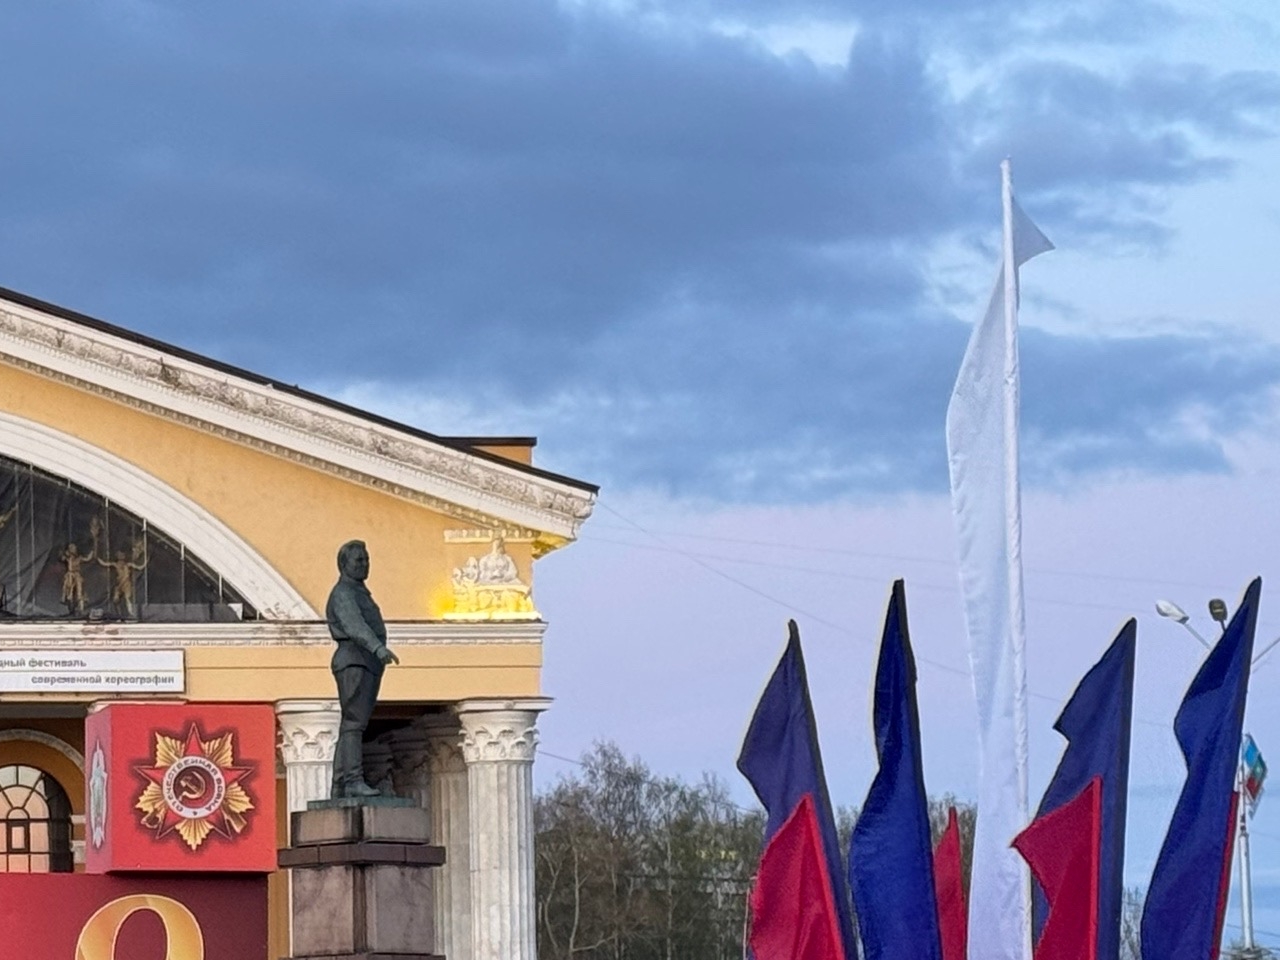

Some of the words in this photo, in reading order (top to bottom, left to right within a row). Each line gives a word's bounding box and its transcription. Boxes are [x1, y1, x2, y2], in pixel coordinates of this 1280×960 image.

[28, 657, 87, 668] фестиваль
[31, 674, 102, 686] современной
[105, 674, 174, 686] хореографии
